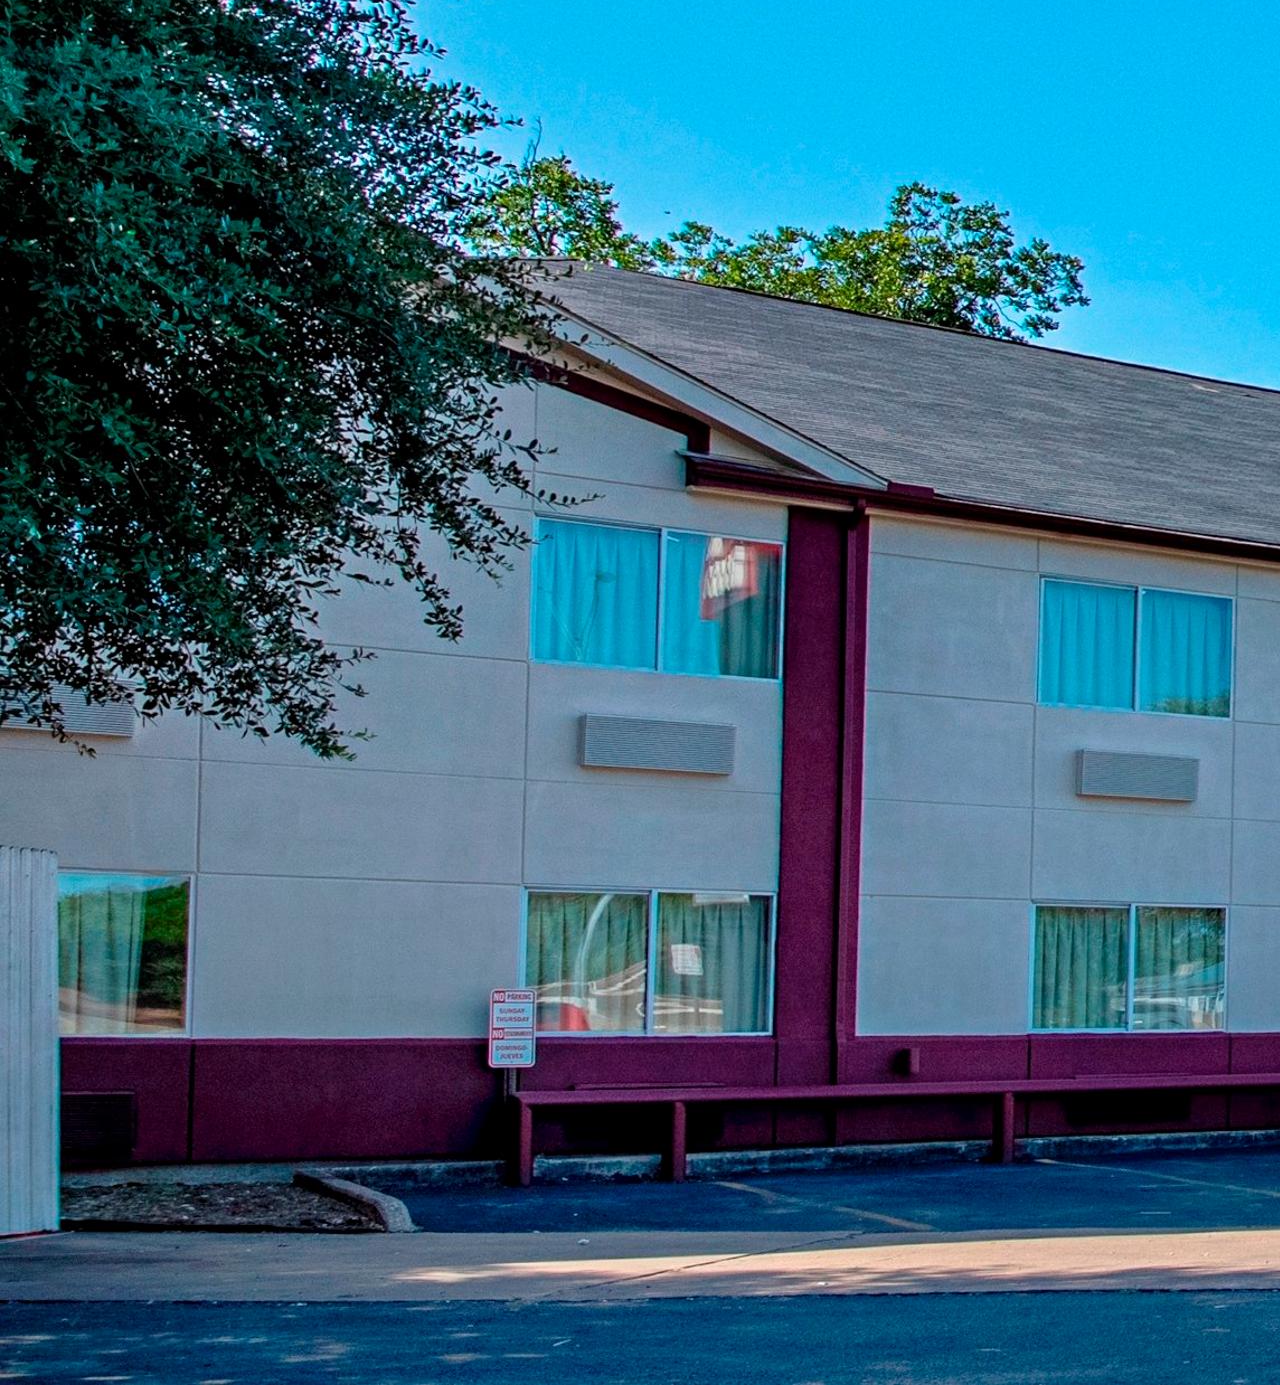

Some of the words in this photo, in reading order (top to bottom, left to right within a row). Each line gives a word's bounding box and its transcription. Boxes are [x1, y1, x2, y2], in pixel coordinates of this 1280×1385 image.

[493, 992, 505, 1002] NO
[507, 993, 532, 1001] PARKING
[492, 1029, 504, 1039] NO
